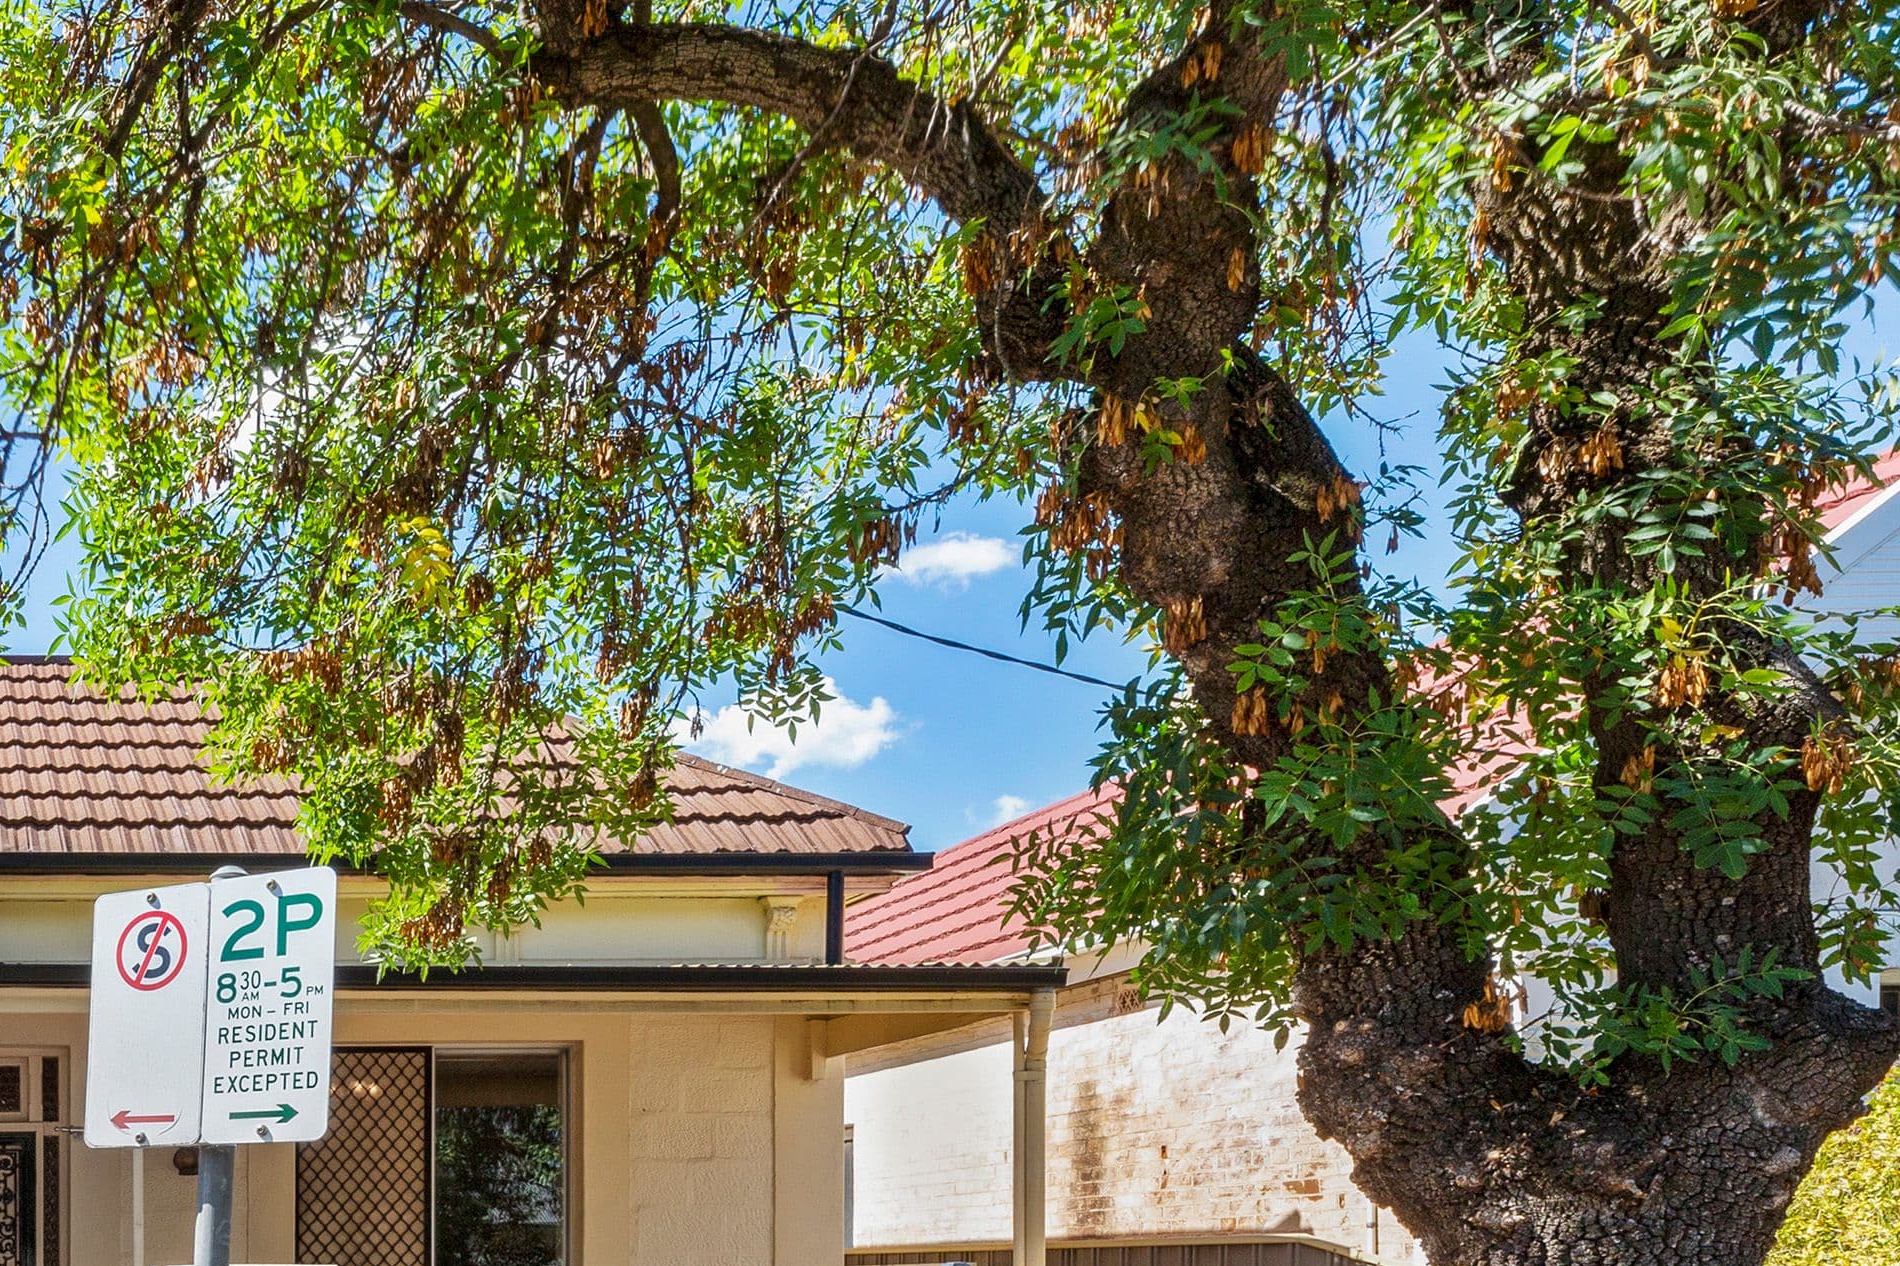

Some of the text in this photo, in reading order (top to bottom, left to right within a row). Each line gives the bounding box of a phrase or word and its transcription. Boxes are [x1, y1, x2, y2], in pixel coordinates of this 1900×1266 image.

[220, 893, 323, 962] 2P
[241, 992, 260, 1001] AM
[306, 985, 324, 996] PM
[227, 1005, 262, 1020] MON
[283, 1001, 310, 1016] FRI
[218, 1020, 318, 1044] RESIDENT
[229, 1046, 304, 1069] PERMIT
[213, 1071, 319, 1094] EXCEPTED
